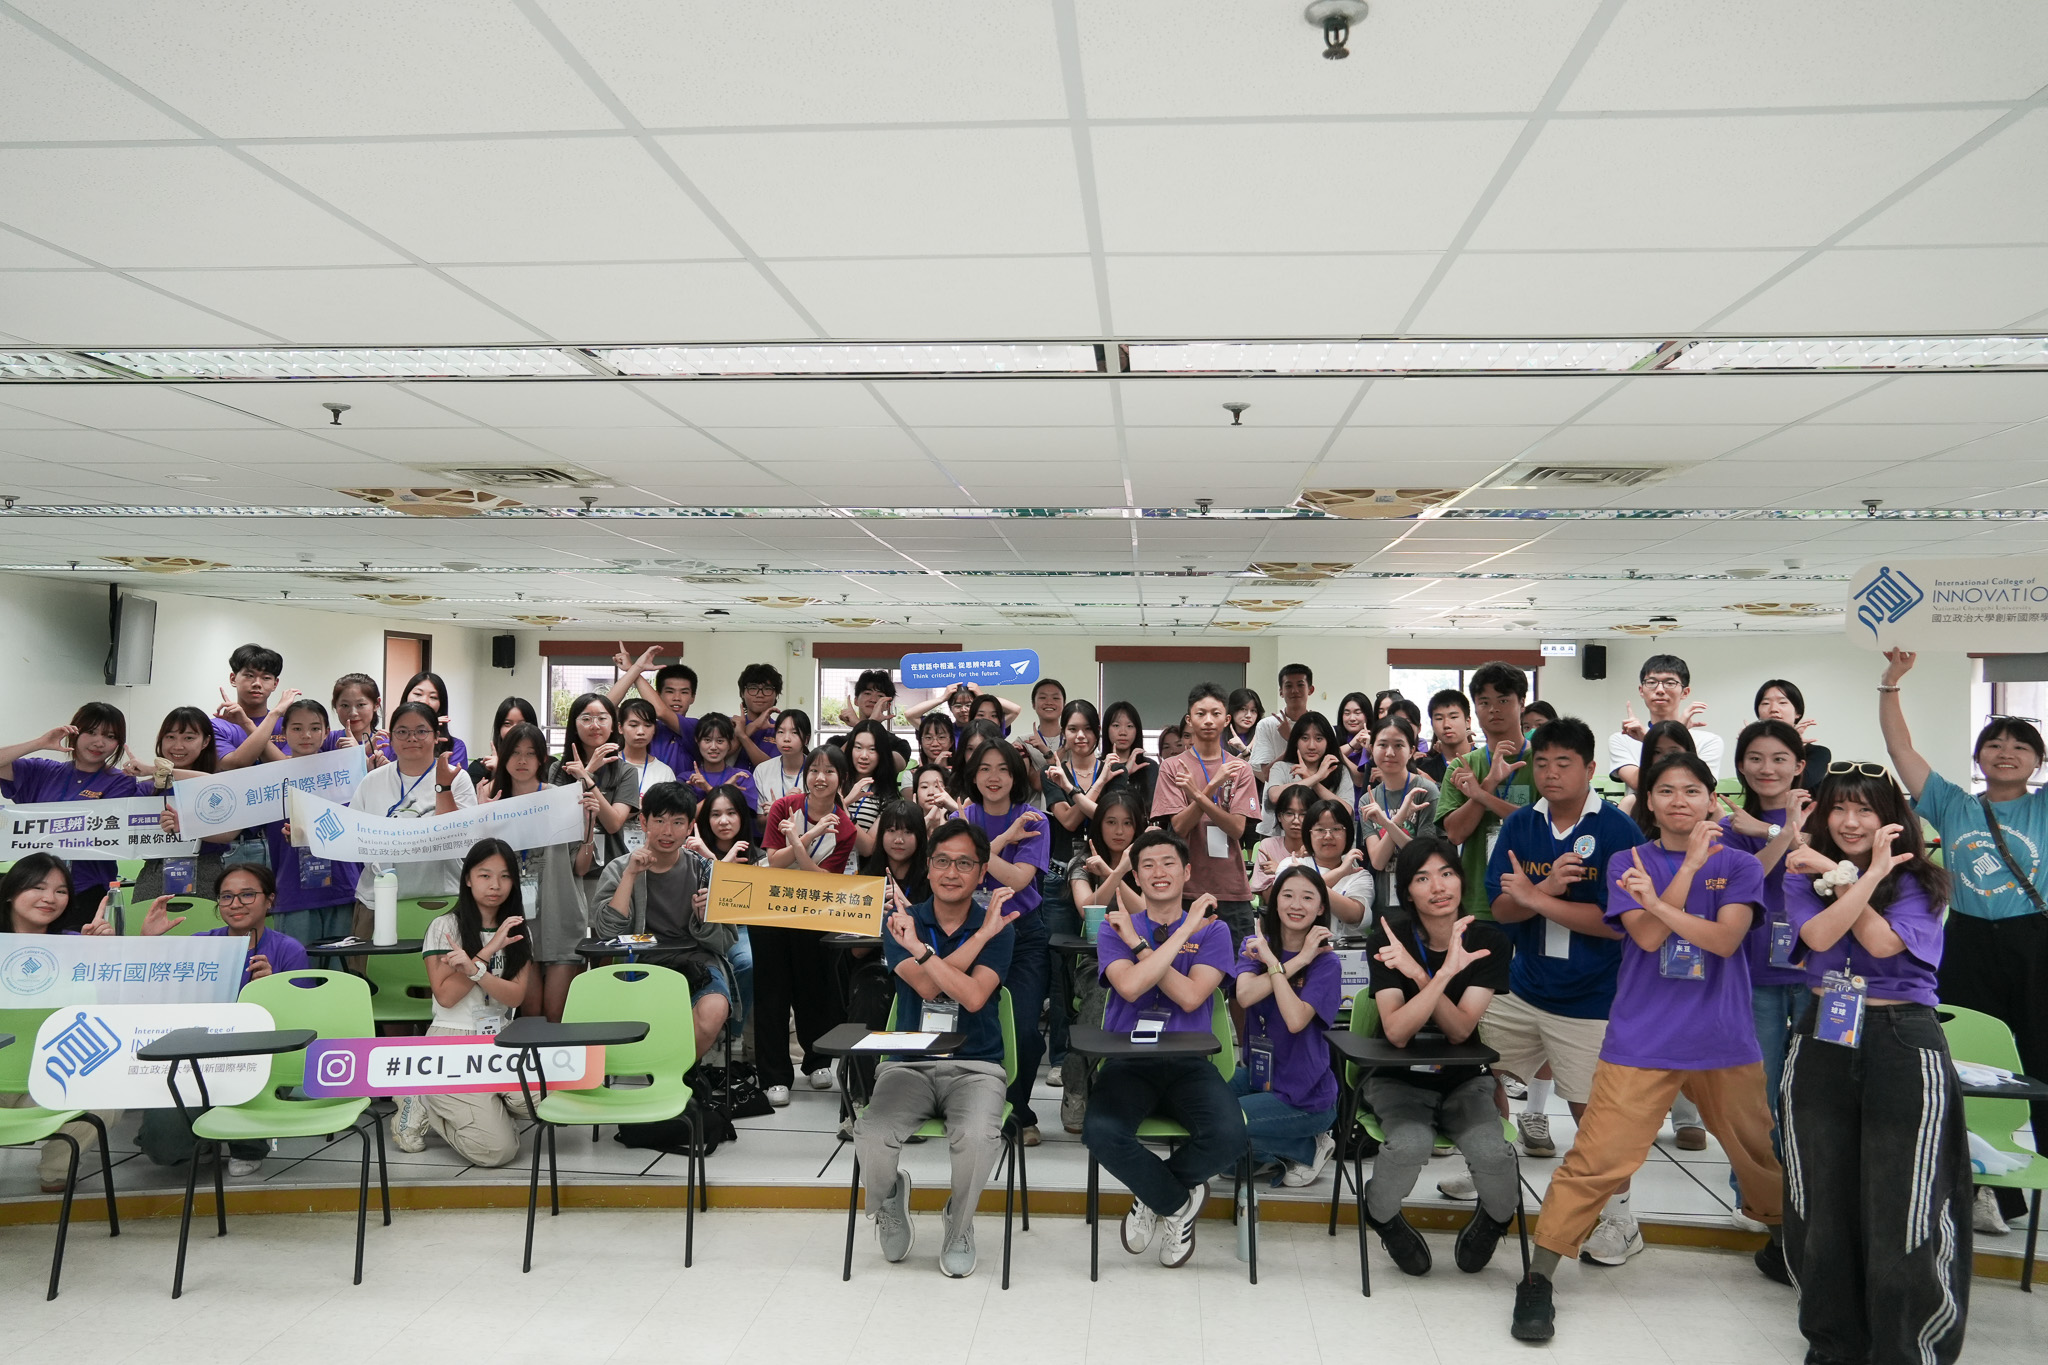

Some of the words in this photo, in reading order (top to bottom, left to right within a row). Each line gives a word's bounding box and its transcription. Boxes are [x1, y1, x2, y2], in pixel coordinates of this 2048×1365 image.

[1991, 578, 2024, 586] College
[357, 822, 430, 836] International
[433, 819, 475, 833] College
[478, 814, 489, 823] of
[492, 804, 550, 821] Innovation
[11, 840, 54, 849] Future
[58, 837, 120, 848] Thinkbox
[429, 831, 468, 843] University
[768, 884, 874, 907] 臺灣領導未來協會
[768, 903, 797, 913] Lead
[802, 906, 823, 915] For
[828, 909, 872, 920] Taiwan
[71, 961, 220, 983] 創新國際學院
[128, 1062, 258, 1076] 國立政治學新國際學院
[386, 1053, 541, 1078] #ICI_NCCU
